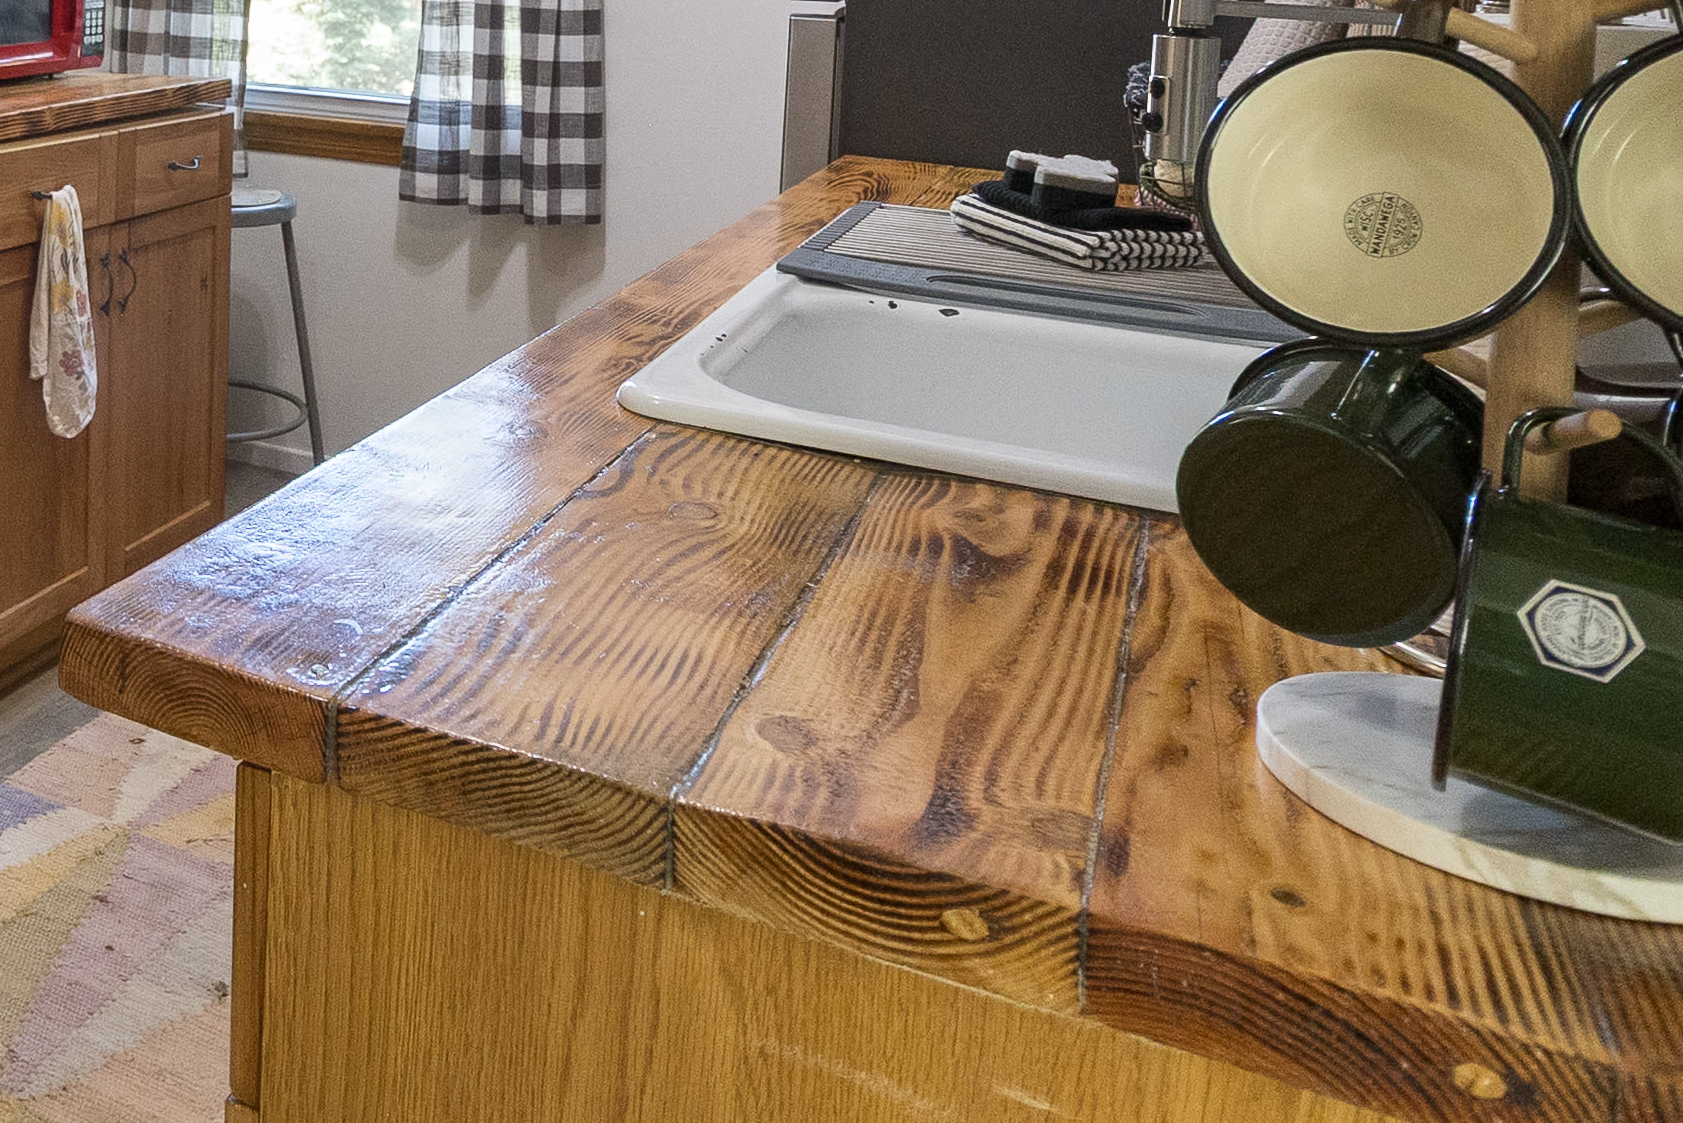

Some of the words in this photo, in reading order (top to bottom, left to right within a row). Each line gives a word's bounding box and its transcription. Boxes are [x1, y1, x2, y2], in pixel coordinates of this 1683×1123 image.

[1347, 227, 1362, 246] MADE
[1356, 196, 1376, 208] CARE
[1370, 197, 1396, 255] WANDAWEGA
[1393, 218, 1407, 239] 1925
[1401, 203, 1420, 230] CANYON
